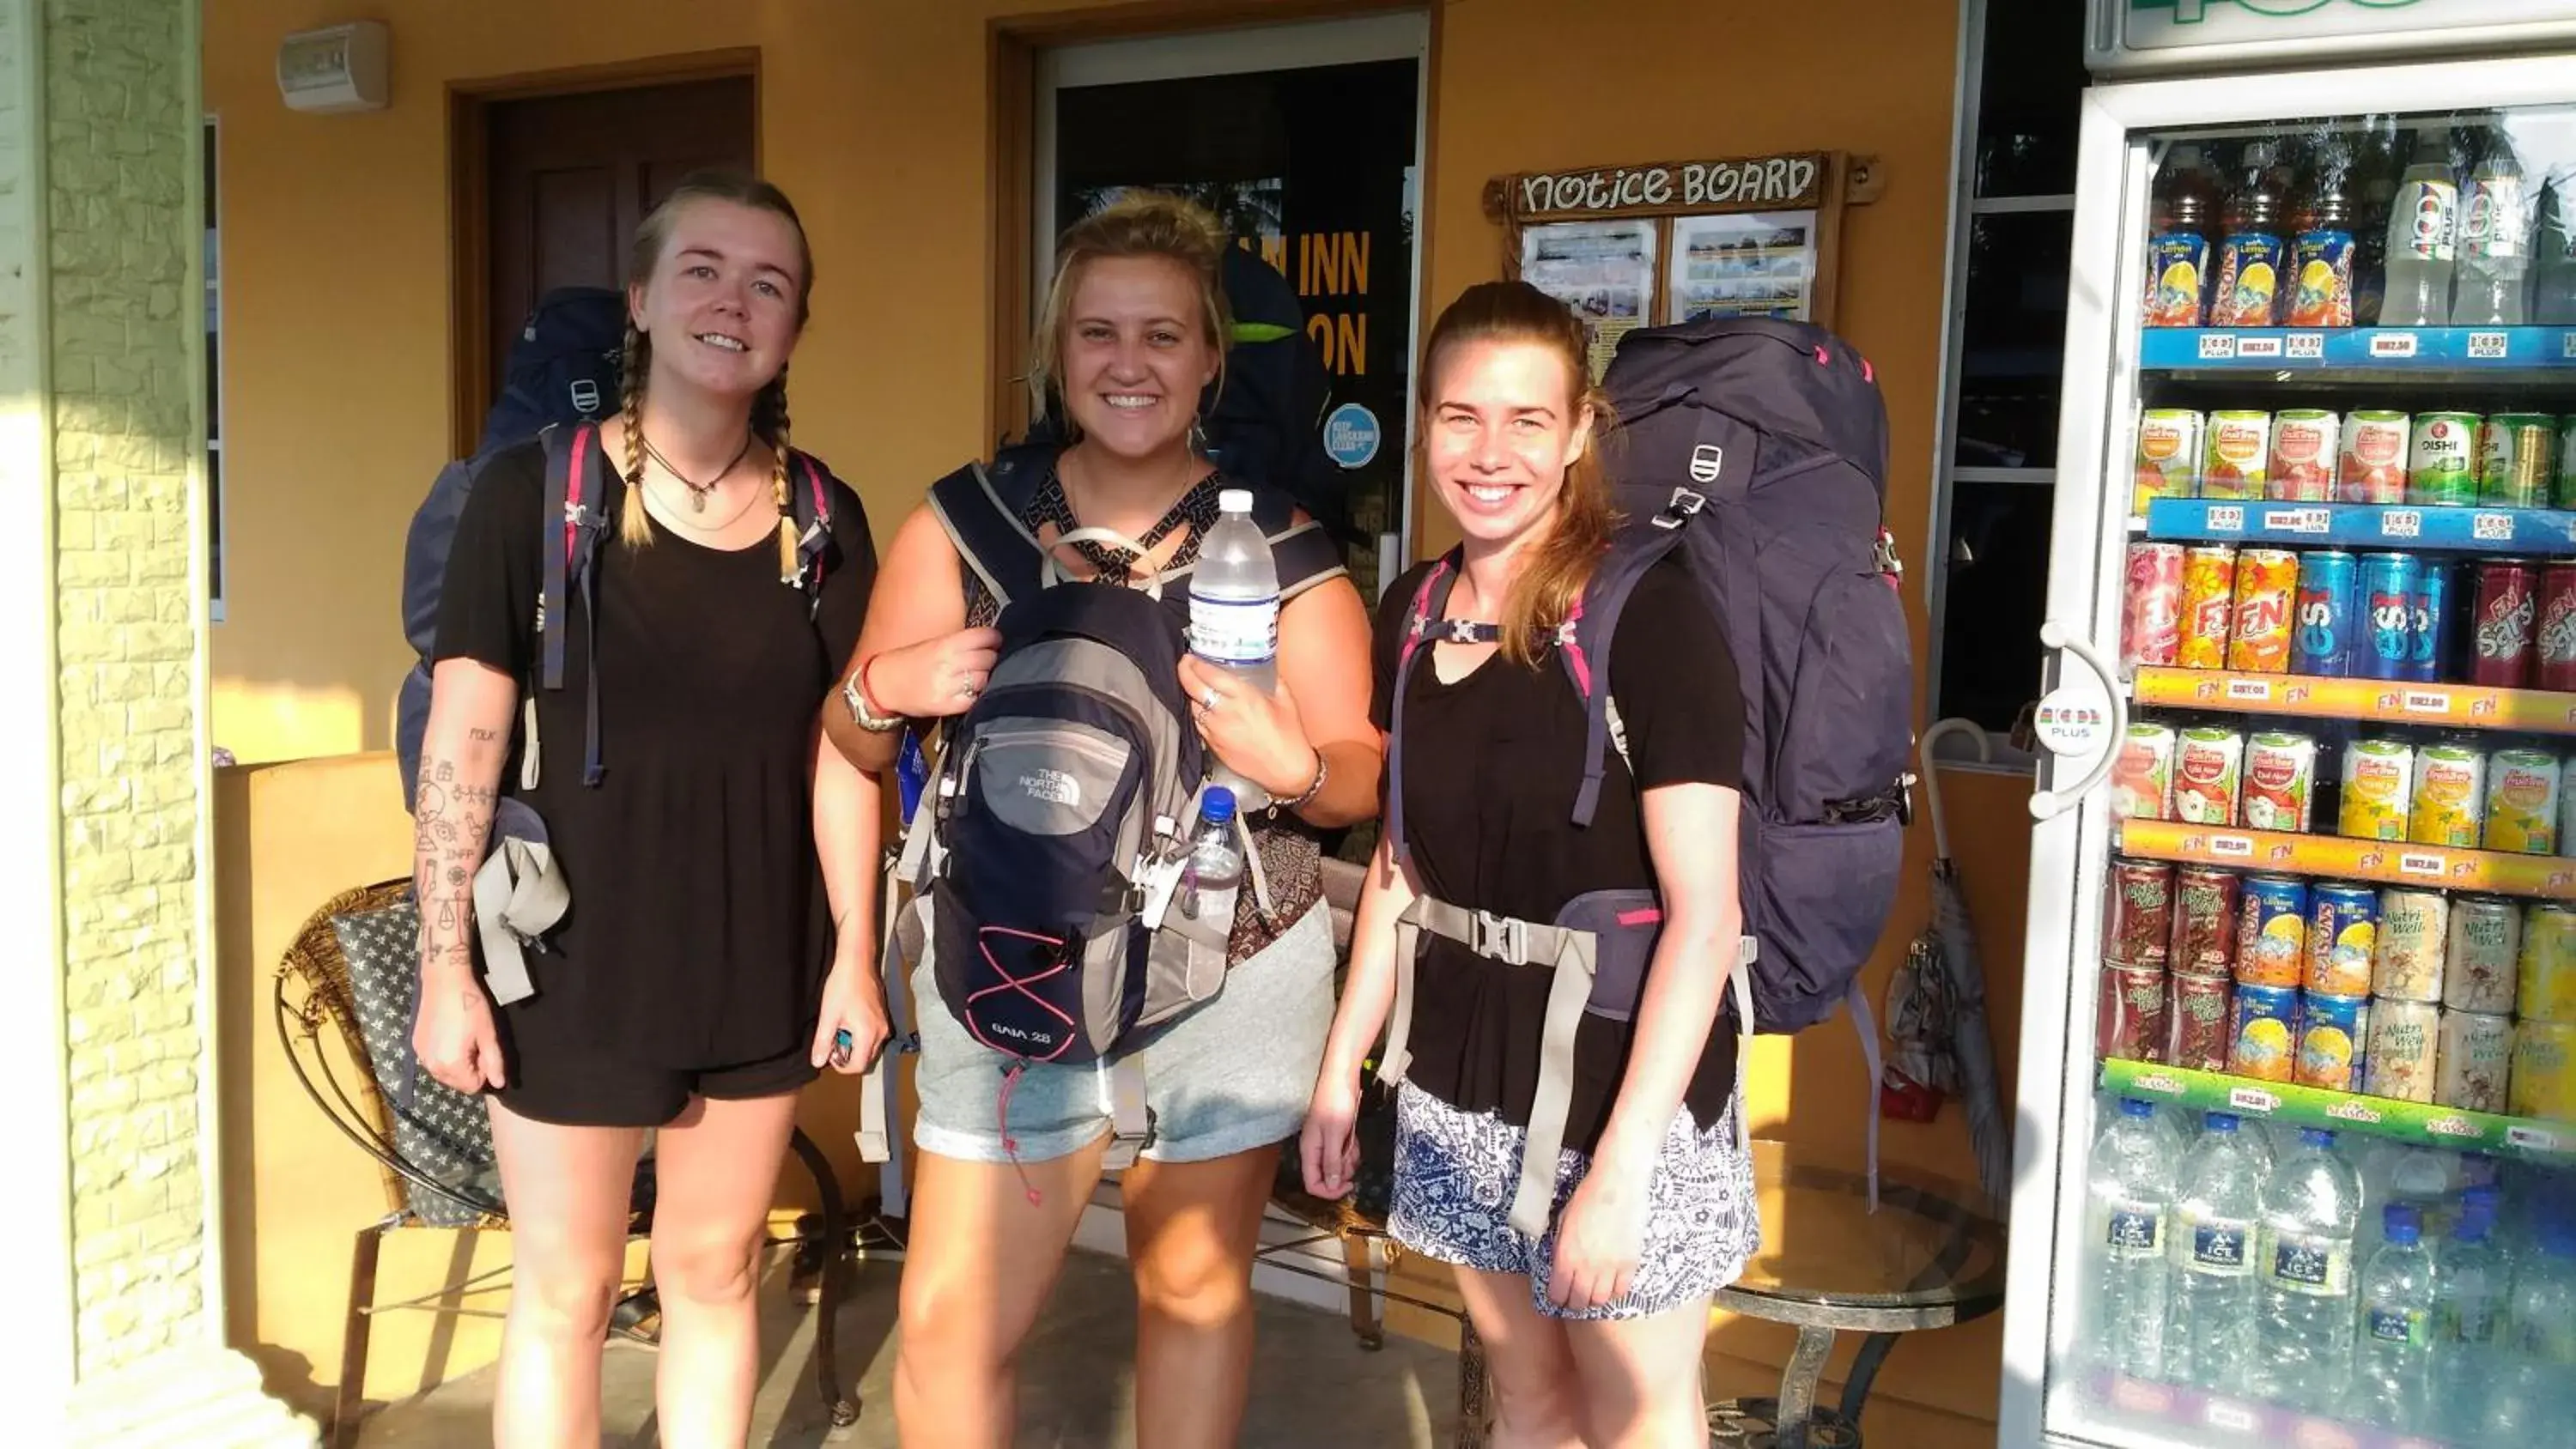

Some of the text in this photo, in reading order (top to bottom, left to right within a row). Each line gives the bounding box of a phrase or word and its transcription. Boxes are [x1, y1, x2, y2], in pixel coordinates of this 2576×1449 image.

[1683, 158, 1814, 205] BOARD
[2441, 207, 2453, 246] PLUS
[1298, 231, 1370, 295] INN
[2421, 440, 2458, 450] OISHI
[2051, 727, 2090, 737] PLUS
[1019, 775, 1062, 791] NORTH
[1037, 768, 1063, 782] THE
[1027, 787, 1065, 803] FACE
[2238, 894, 2261, 974] SEASONS
[2314, 903, 2335, 985] SEASONS
[1031, 1031, 1051, 1044] 28
